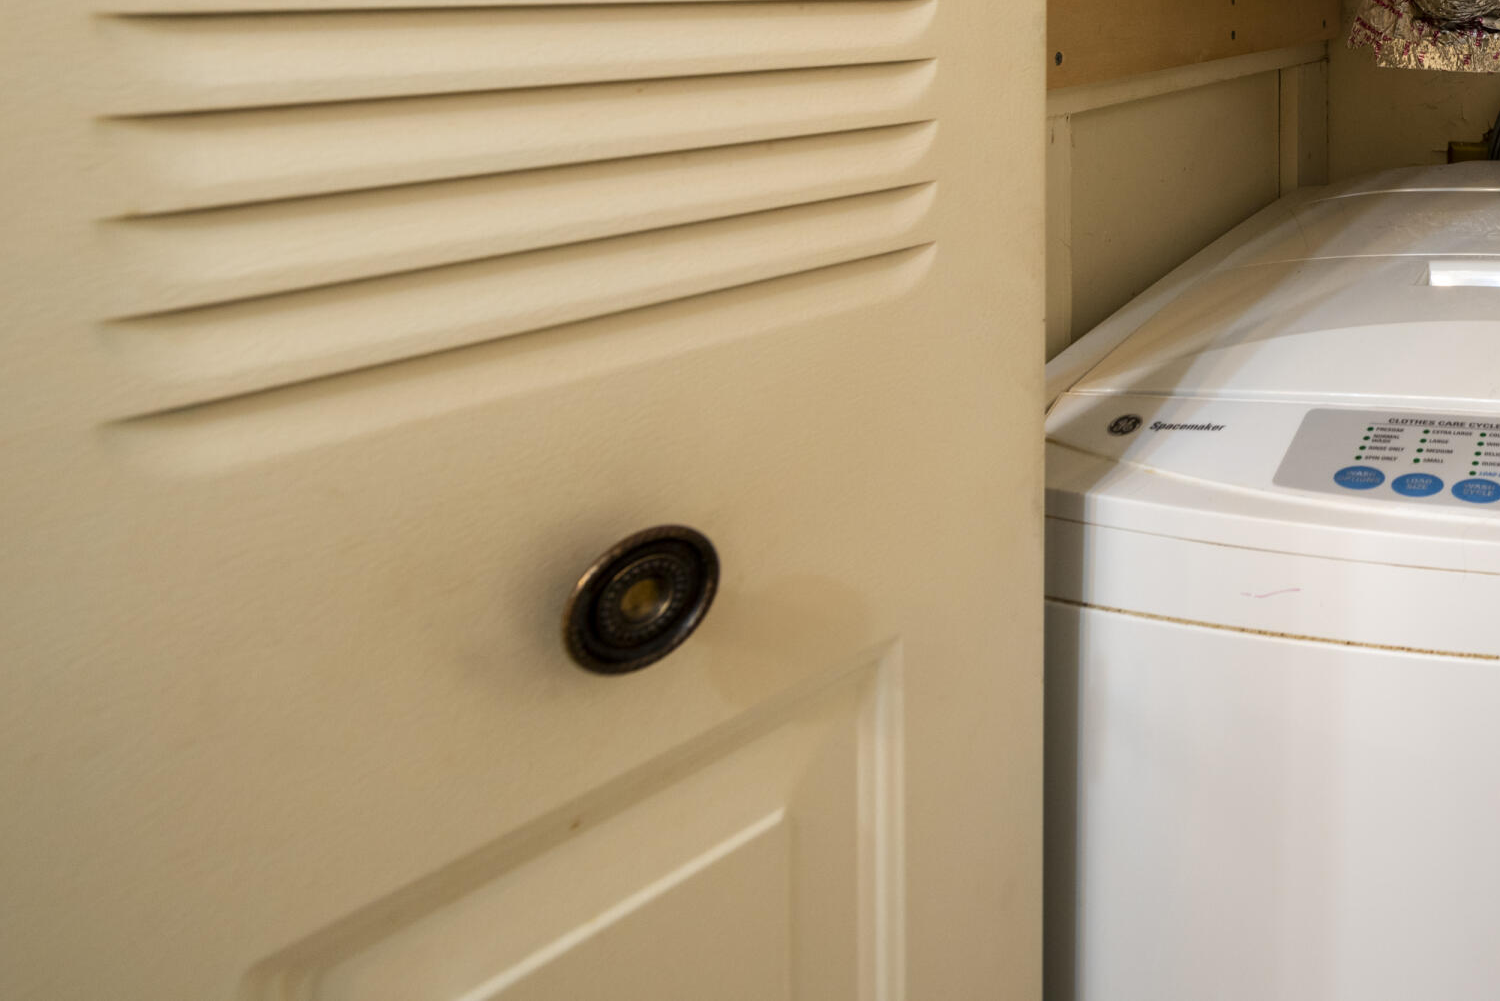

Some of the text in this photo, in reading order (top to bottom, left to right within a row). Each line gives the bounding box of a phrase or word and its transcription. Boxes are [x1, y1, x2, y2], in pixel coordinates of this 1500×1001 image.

[1149, 420, 1226, 432] Spacemaker
[1388, 417, 1436, 427] CLOTHES
[1438, 419, 1466, 428] CARE
[1469, 421, 1500, 430] CYCLE
